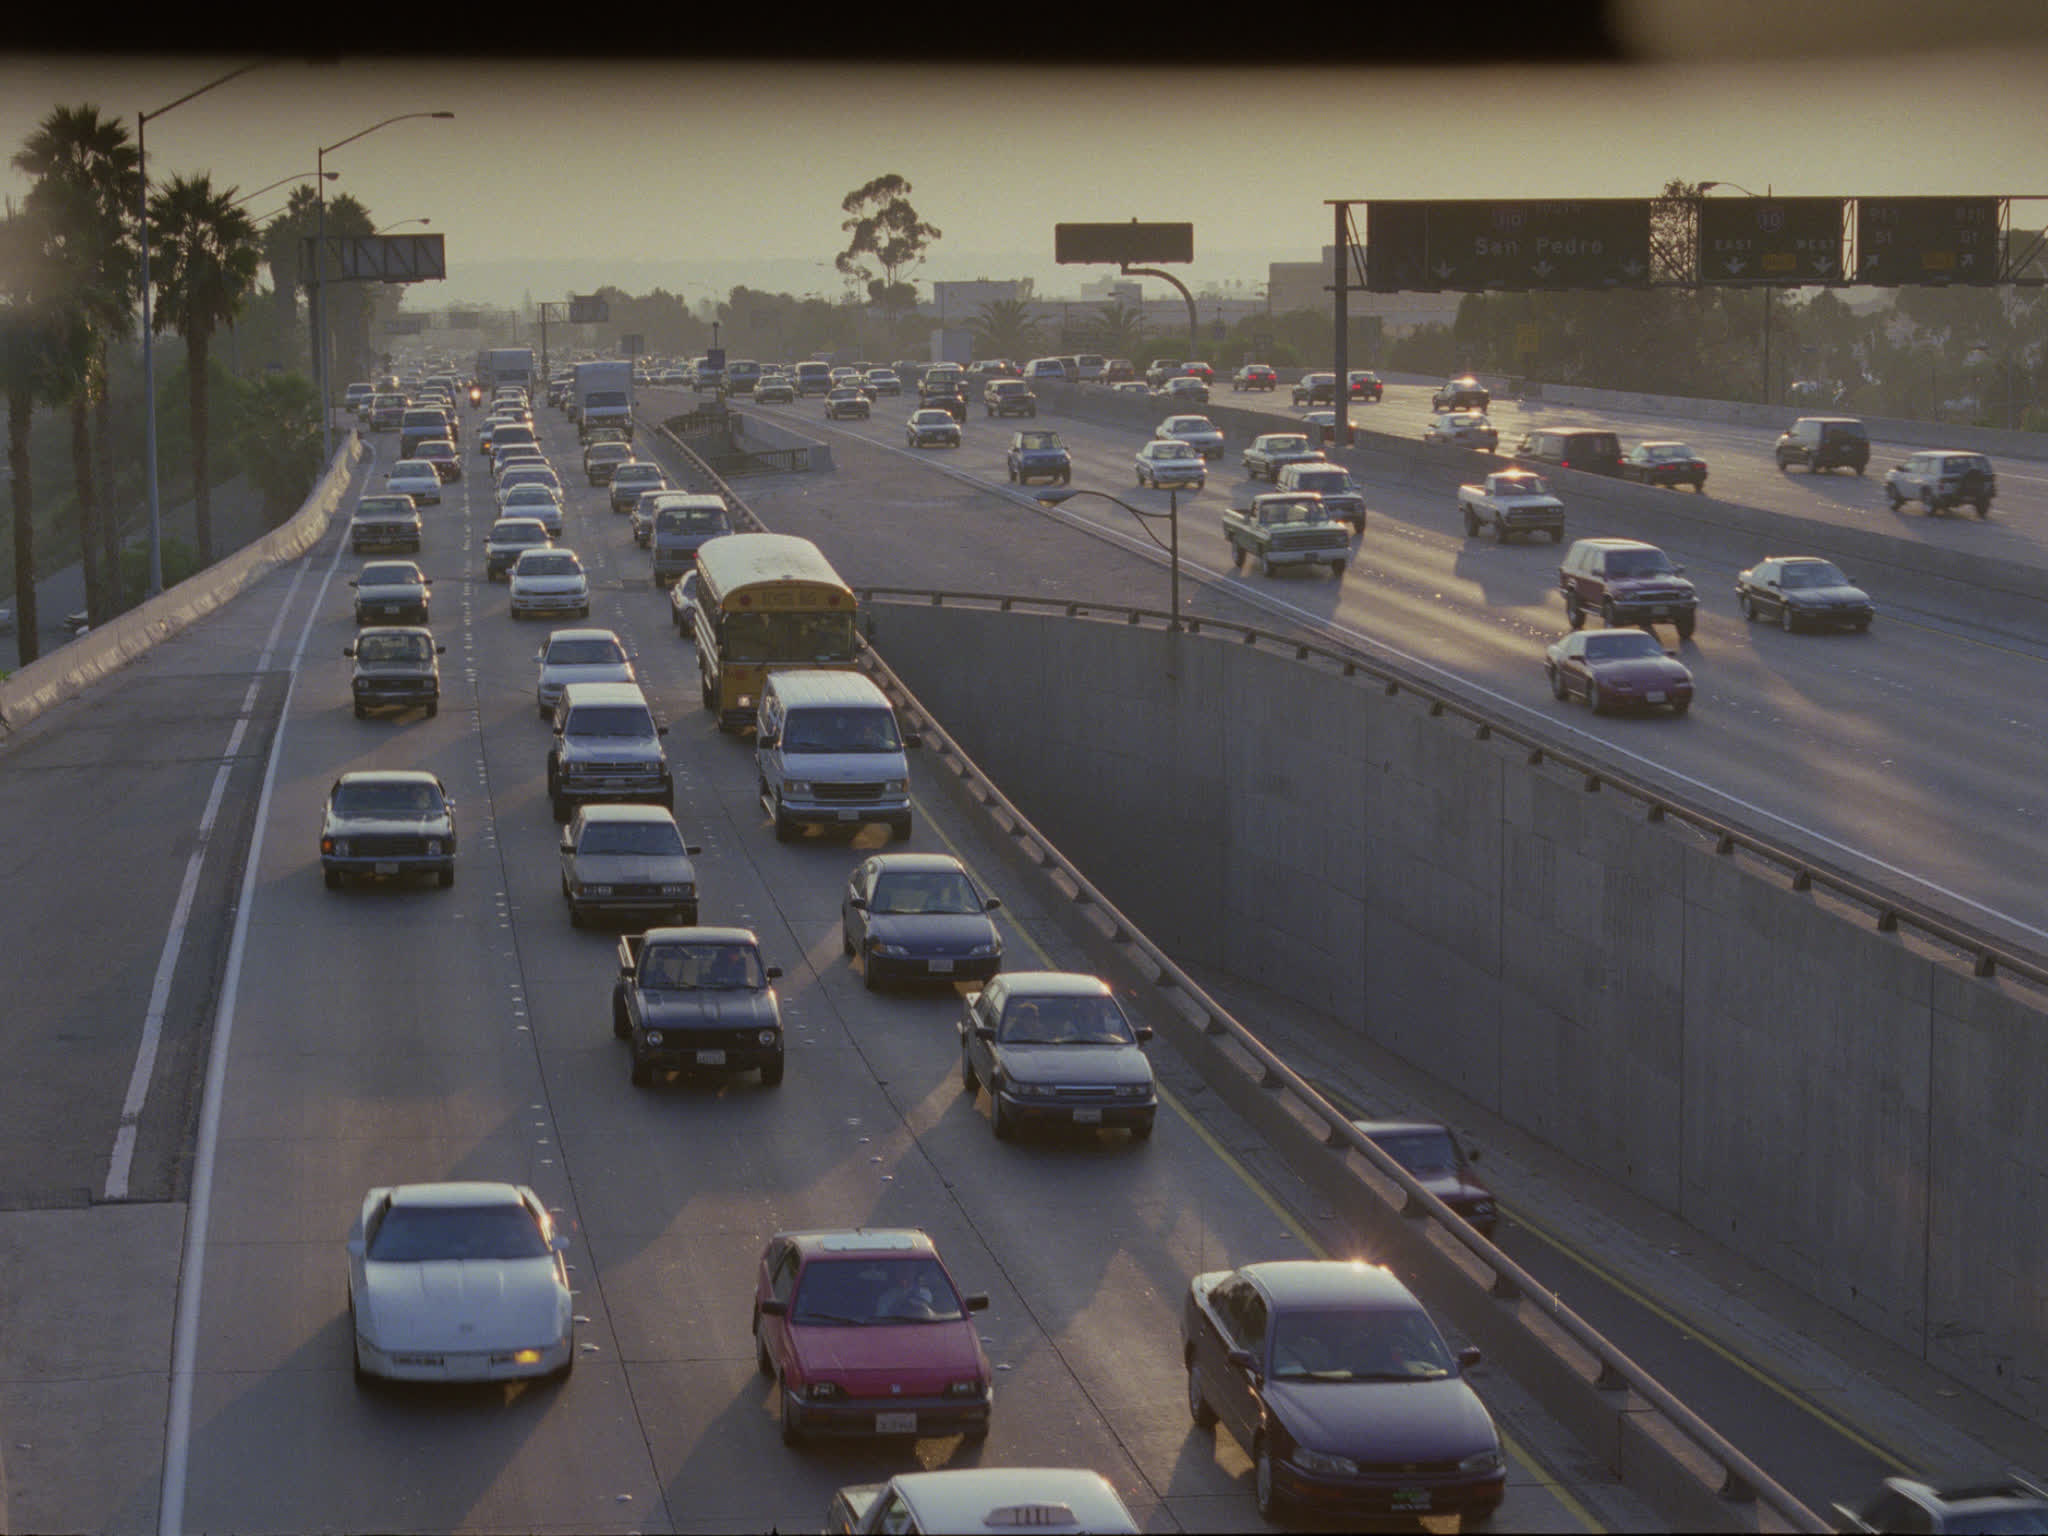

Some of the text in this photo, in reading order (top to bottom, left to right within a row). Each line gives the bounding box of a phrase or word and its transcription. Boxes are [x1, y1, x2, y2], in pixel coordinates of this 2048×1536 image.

[1474, 234, 1604, 256] San Pedro
[1714, 239, 1753, 250] EAST
[1795, 239, 1836, 250] WEST
